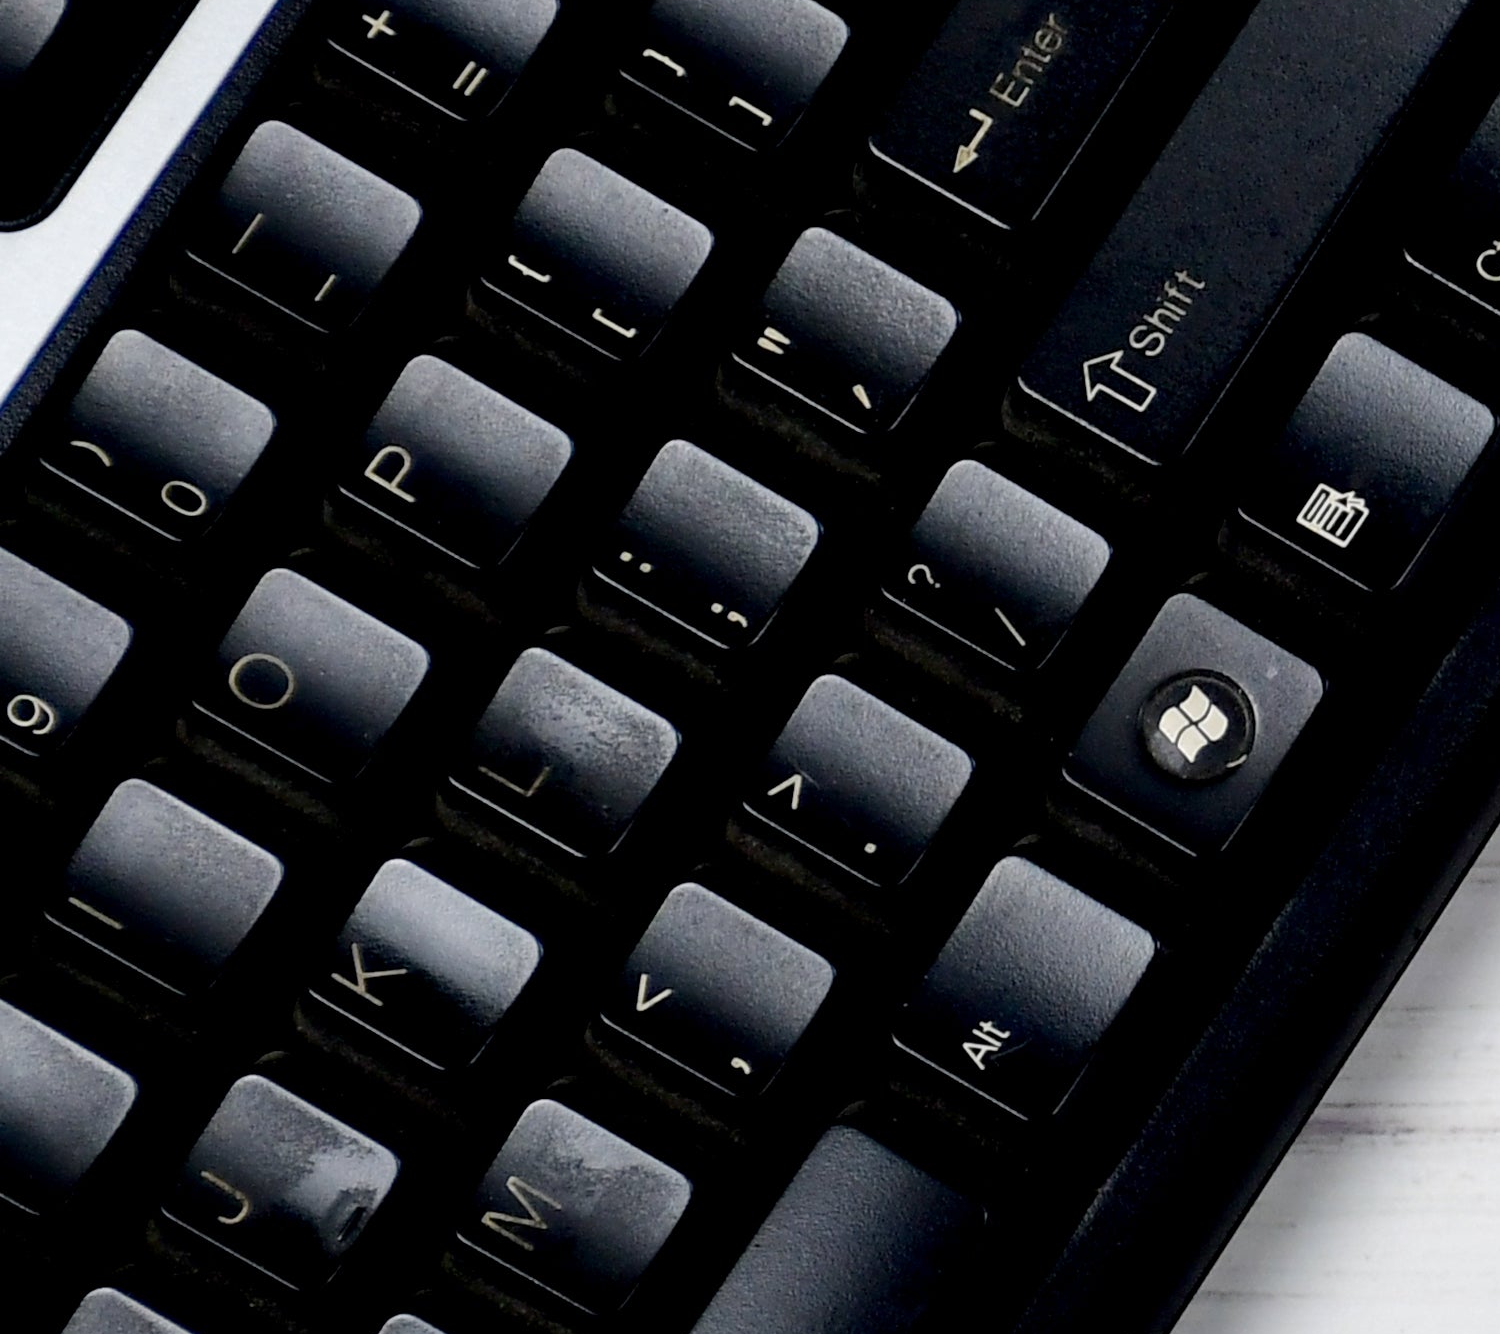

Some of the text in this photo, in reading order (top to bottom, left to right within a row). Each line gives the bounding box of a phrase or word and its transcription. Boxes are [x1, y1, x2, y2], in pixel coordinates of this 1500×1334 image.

[990, 12, 1069, 110] Enter
[1127, 267, 1206, 359] Shift
[160, 480, 208, 517] 0
[364, 443, 417, 505] P
[228, 652, 295, 710] O
[6, 692, 55, 735] 9
[477, 764, 552, 798] L
[330, 943, 409, 1007] K
[961, 1019, 1012, 1071] Alt
[200, 1169, 252, 1225] J
[481, 1174, 563, 1251] M
